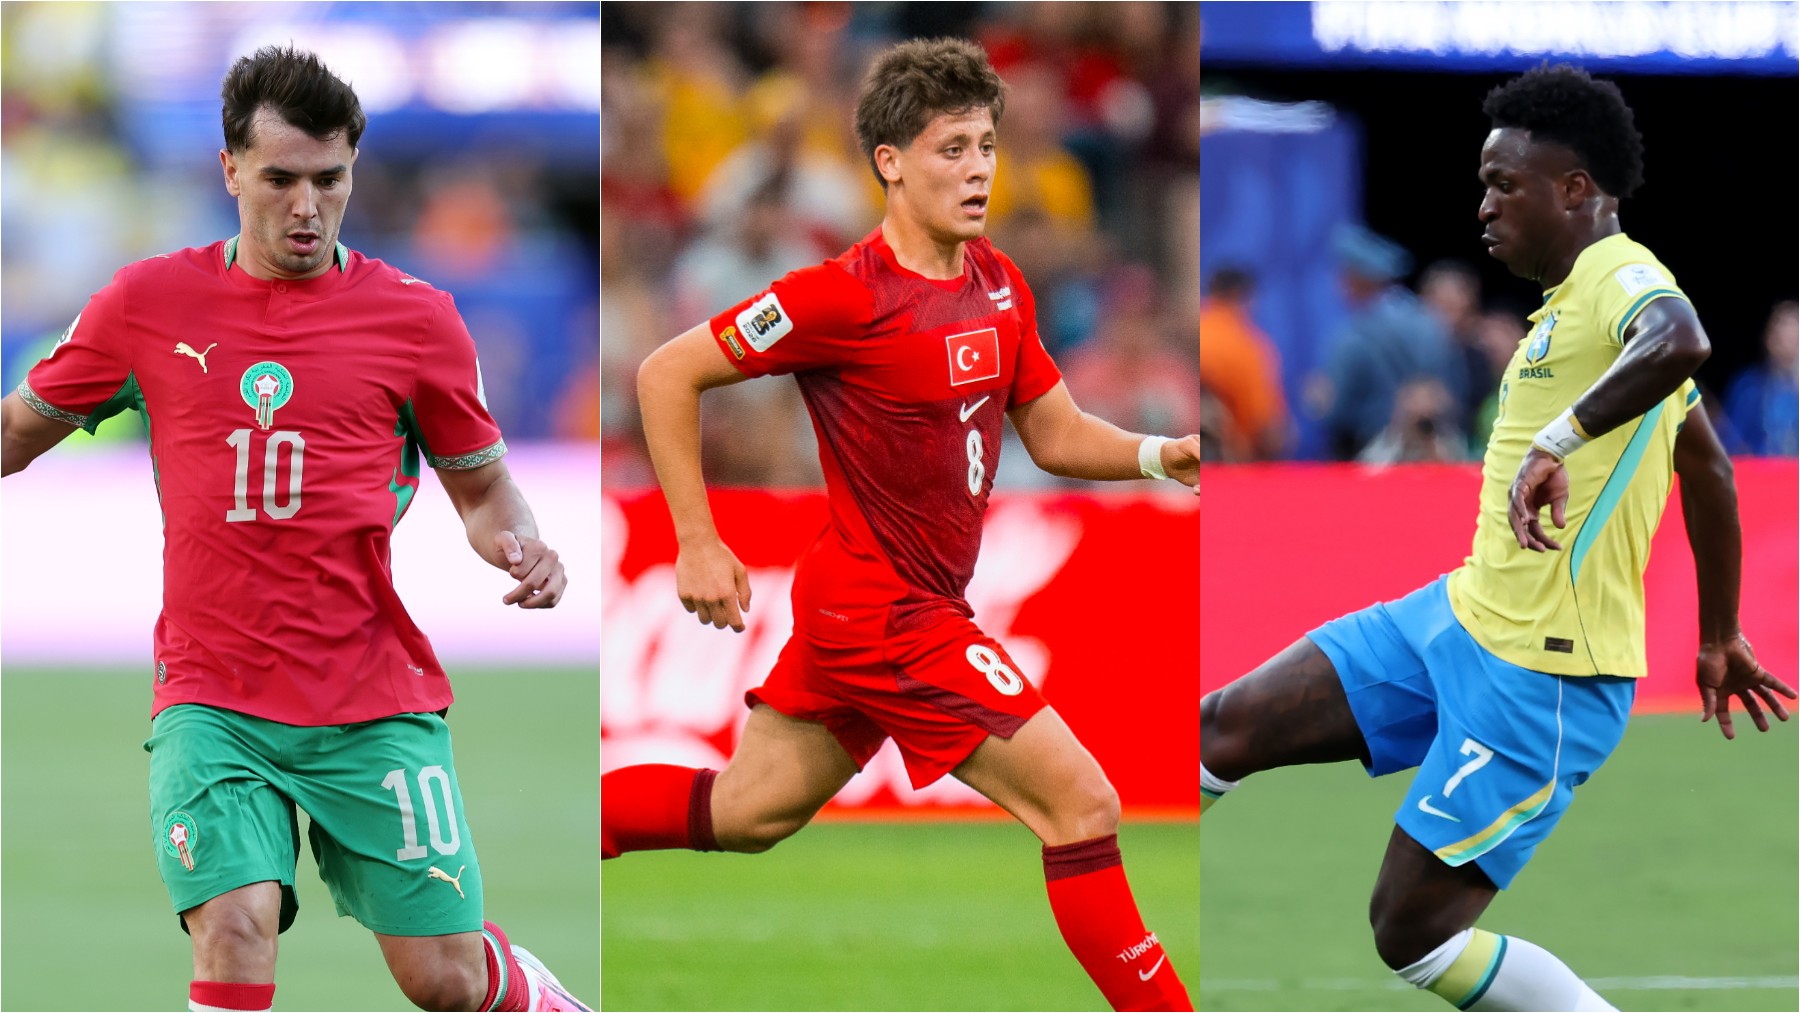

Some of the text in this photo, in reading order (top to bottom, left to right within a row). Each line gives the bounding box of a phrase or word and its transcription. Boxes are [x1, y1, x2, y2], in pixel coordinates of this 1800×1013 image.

[1519, 368, 1554, 379] BRASIL
[225, 428, 306, 523] 10
[966, 429, 985, 497] 8
[965, 644, 1024, 696] 8
[1442, 738, 1495, 799] 7
[381, 765, 461, 862] 10
